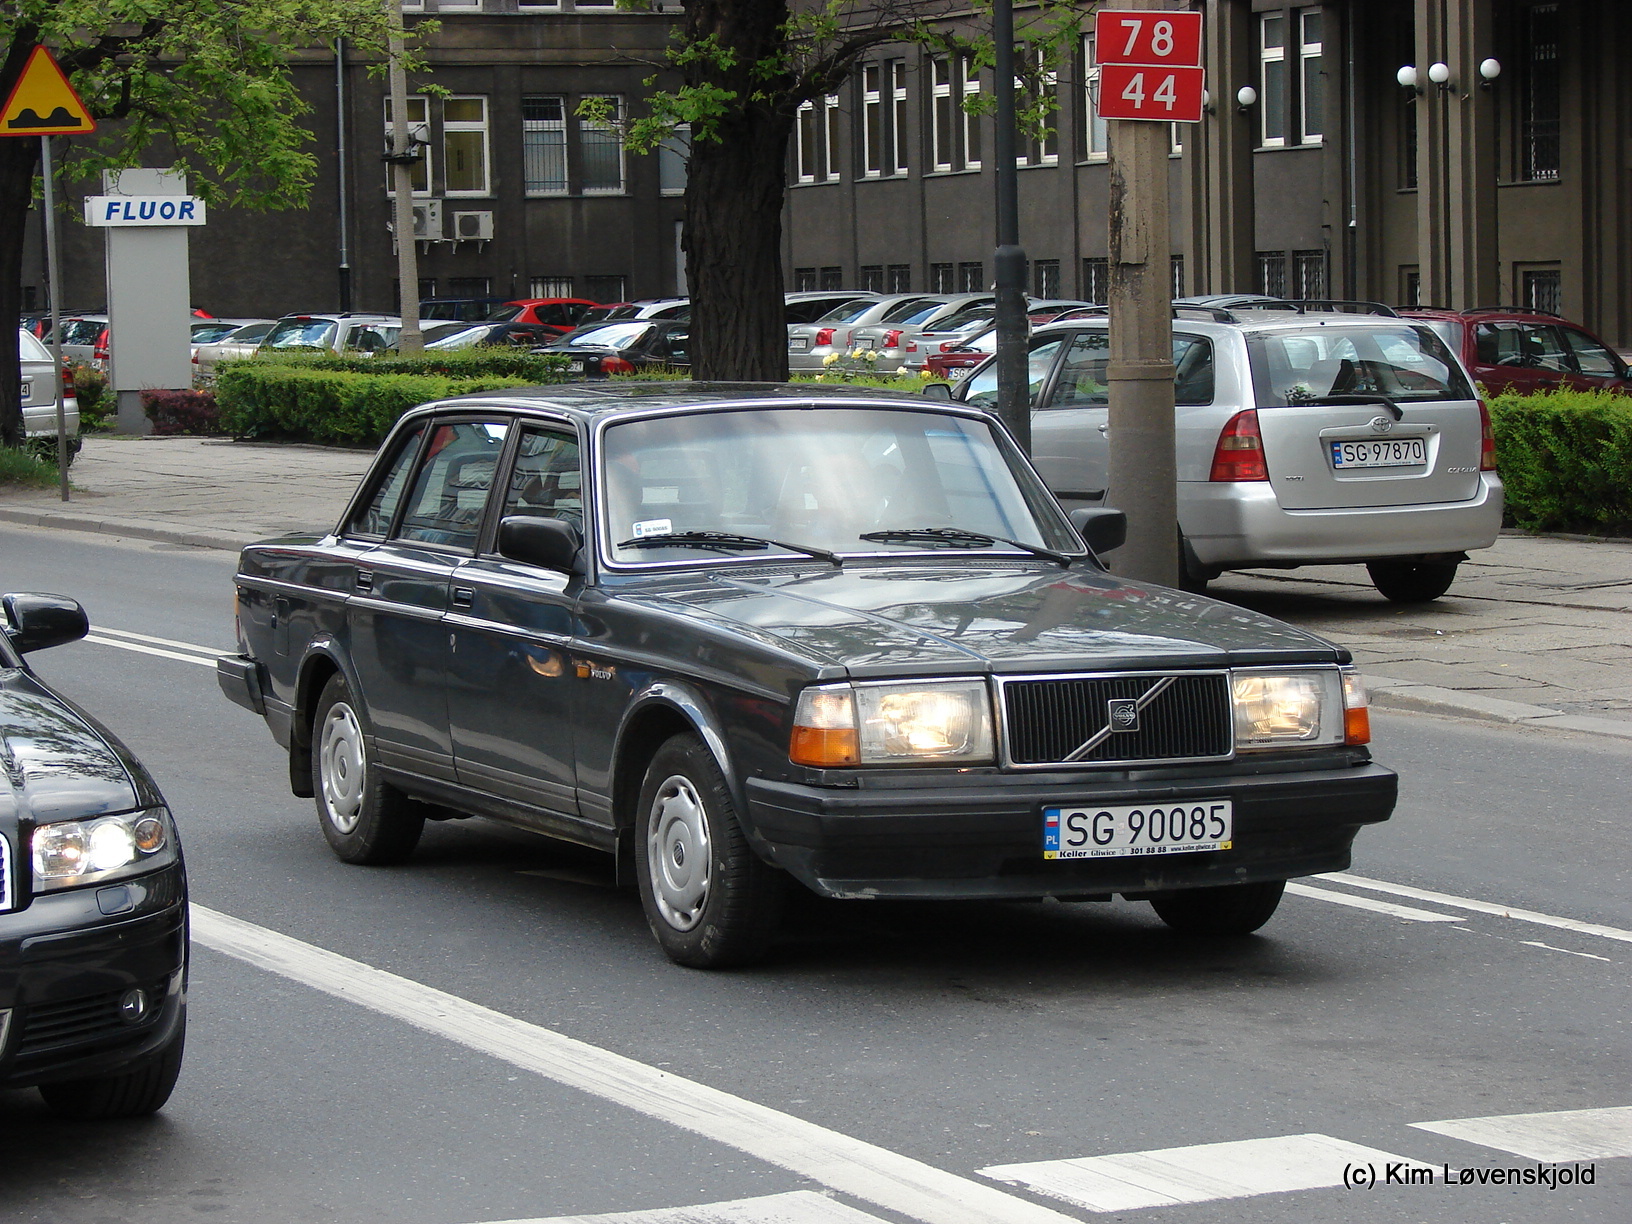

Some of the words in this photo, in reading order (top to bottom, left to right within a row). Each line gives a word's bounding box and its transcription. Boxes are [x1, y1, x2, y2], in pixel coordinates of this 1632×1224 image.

[1121, 19, 1174, 57] 78
[1121, 72, 1177, 111] 44
[105, 201, 195, 221] FLUOR
[1343, 443, 1368, 462] SG
[1372, 441, 1422, 462] 97870
[590, 669, 612, 680] VOLVO
[1045, 835, 1058, 846] PL
[1066, 811, 1115, 847] SG
[1128, 804, 1226, 845] 90085
[1059, 850, 1087, 858] Keller
[1091, 848, 1117, 857] Gliwice
[1129, 847, 1143, 855] 301
[1146, 846, 1155, 854] 88
[1157, 845, 1167, 853] 88
